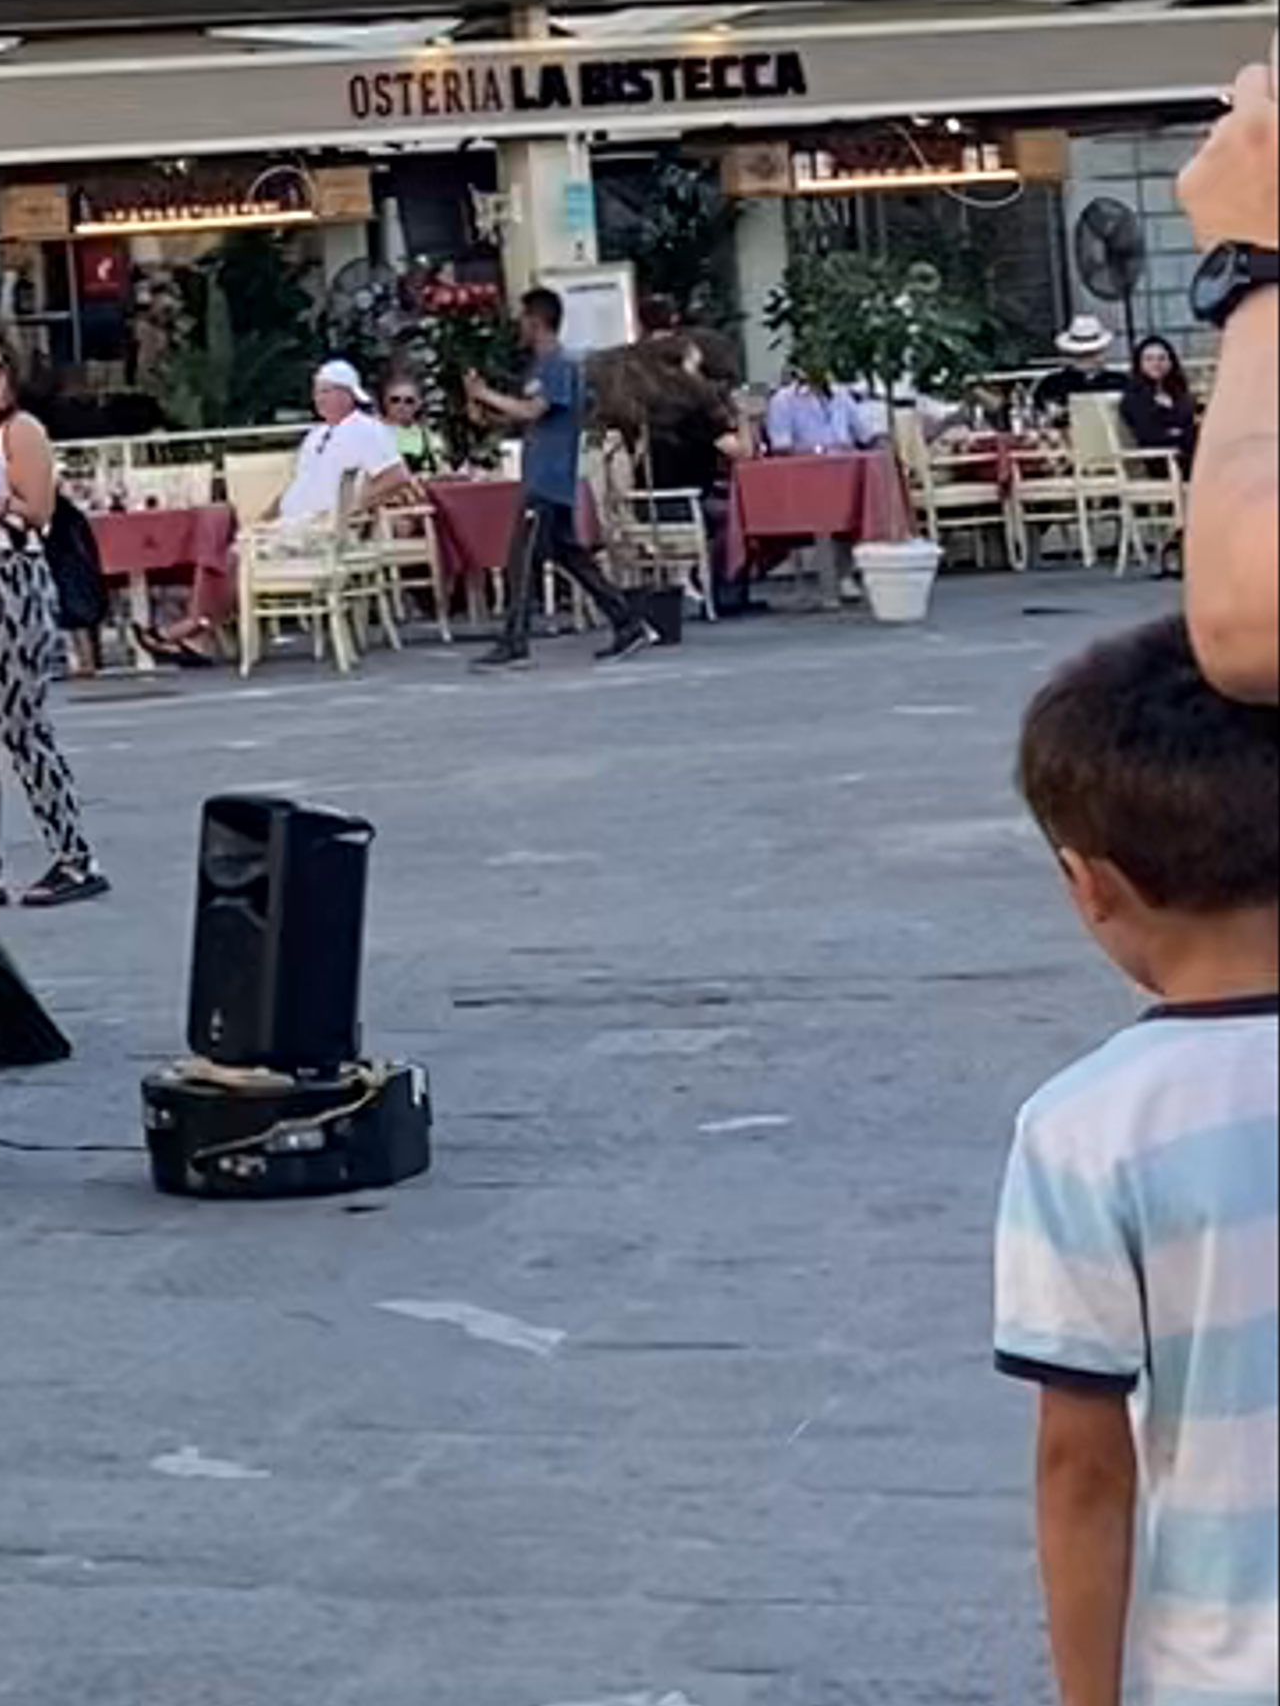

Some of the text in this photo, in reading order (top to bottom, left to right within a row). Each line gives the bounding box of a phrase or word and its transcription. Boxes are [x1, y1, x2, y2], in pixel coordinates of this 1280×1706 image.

[348, 51, 807, 120] OSTERIA LA BISTECCA
